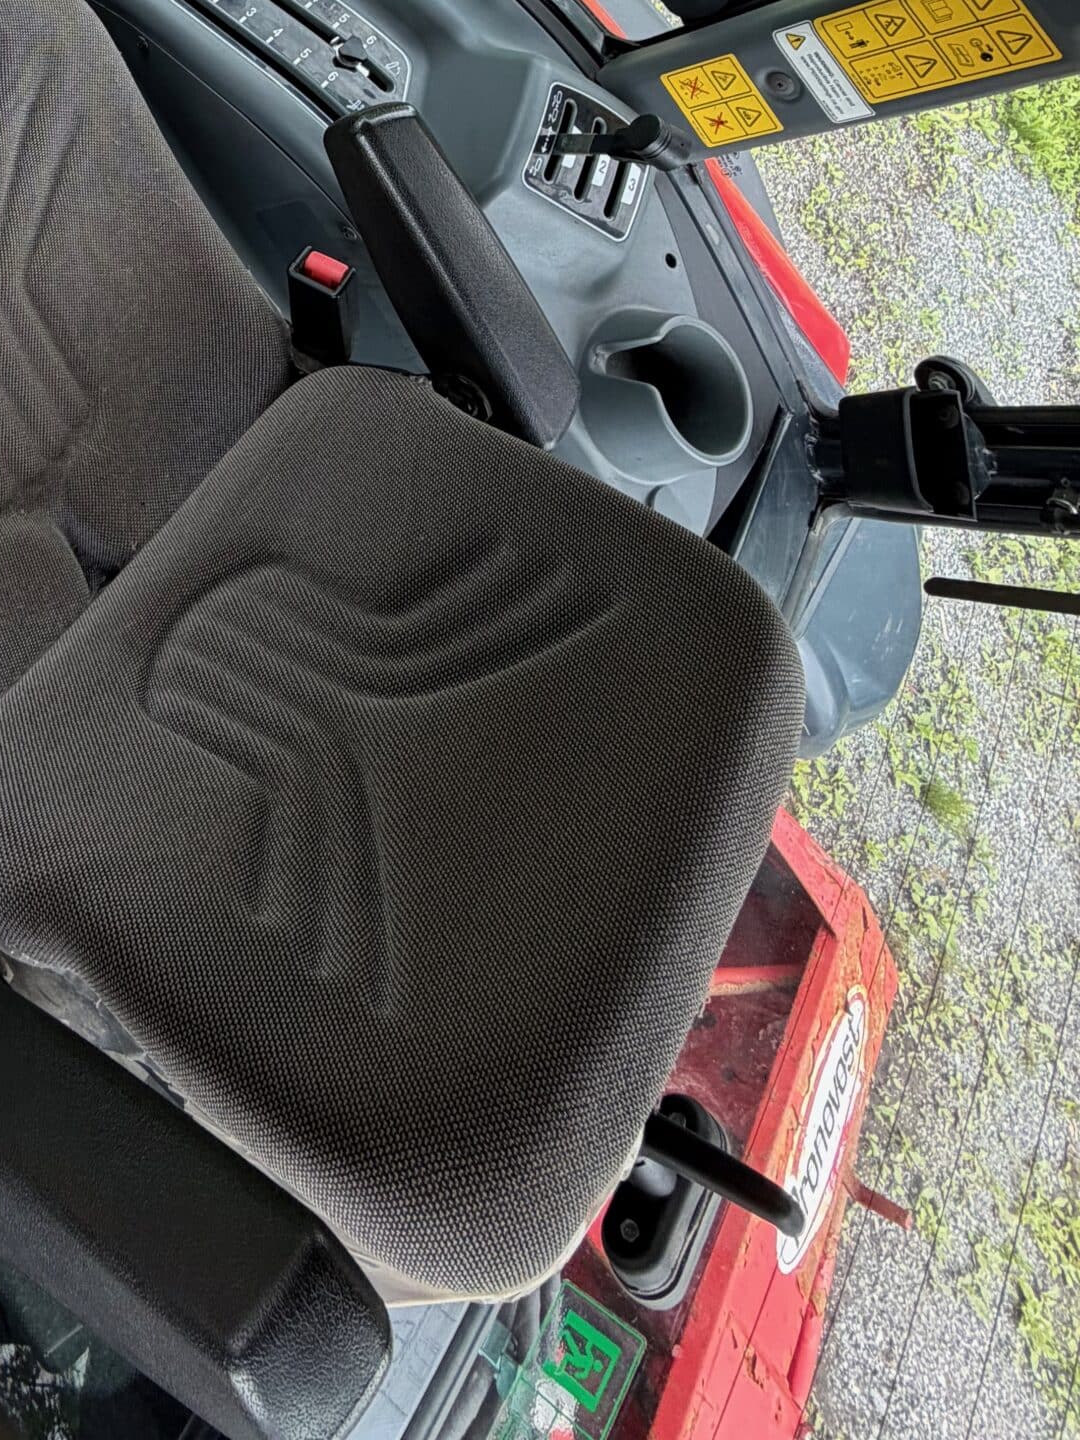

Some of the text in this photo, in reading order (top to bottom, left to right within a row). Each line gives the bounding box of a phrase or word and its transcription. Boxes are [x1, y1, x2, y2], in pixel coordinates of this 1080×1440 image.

[246, 7, 258, 18] 3
[338, 12, 350, 23] 5
[272, 27, 284, 38] 4
[366, 35, 377, 46] 6
[300, 47, 312, 59] 5
[328, 71, 339, 83] 6
[598, 160, 607, 174] 2
